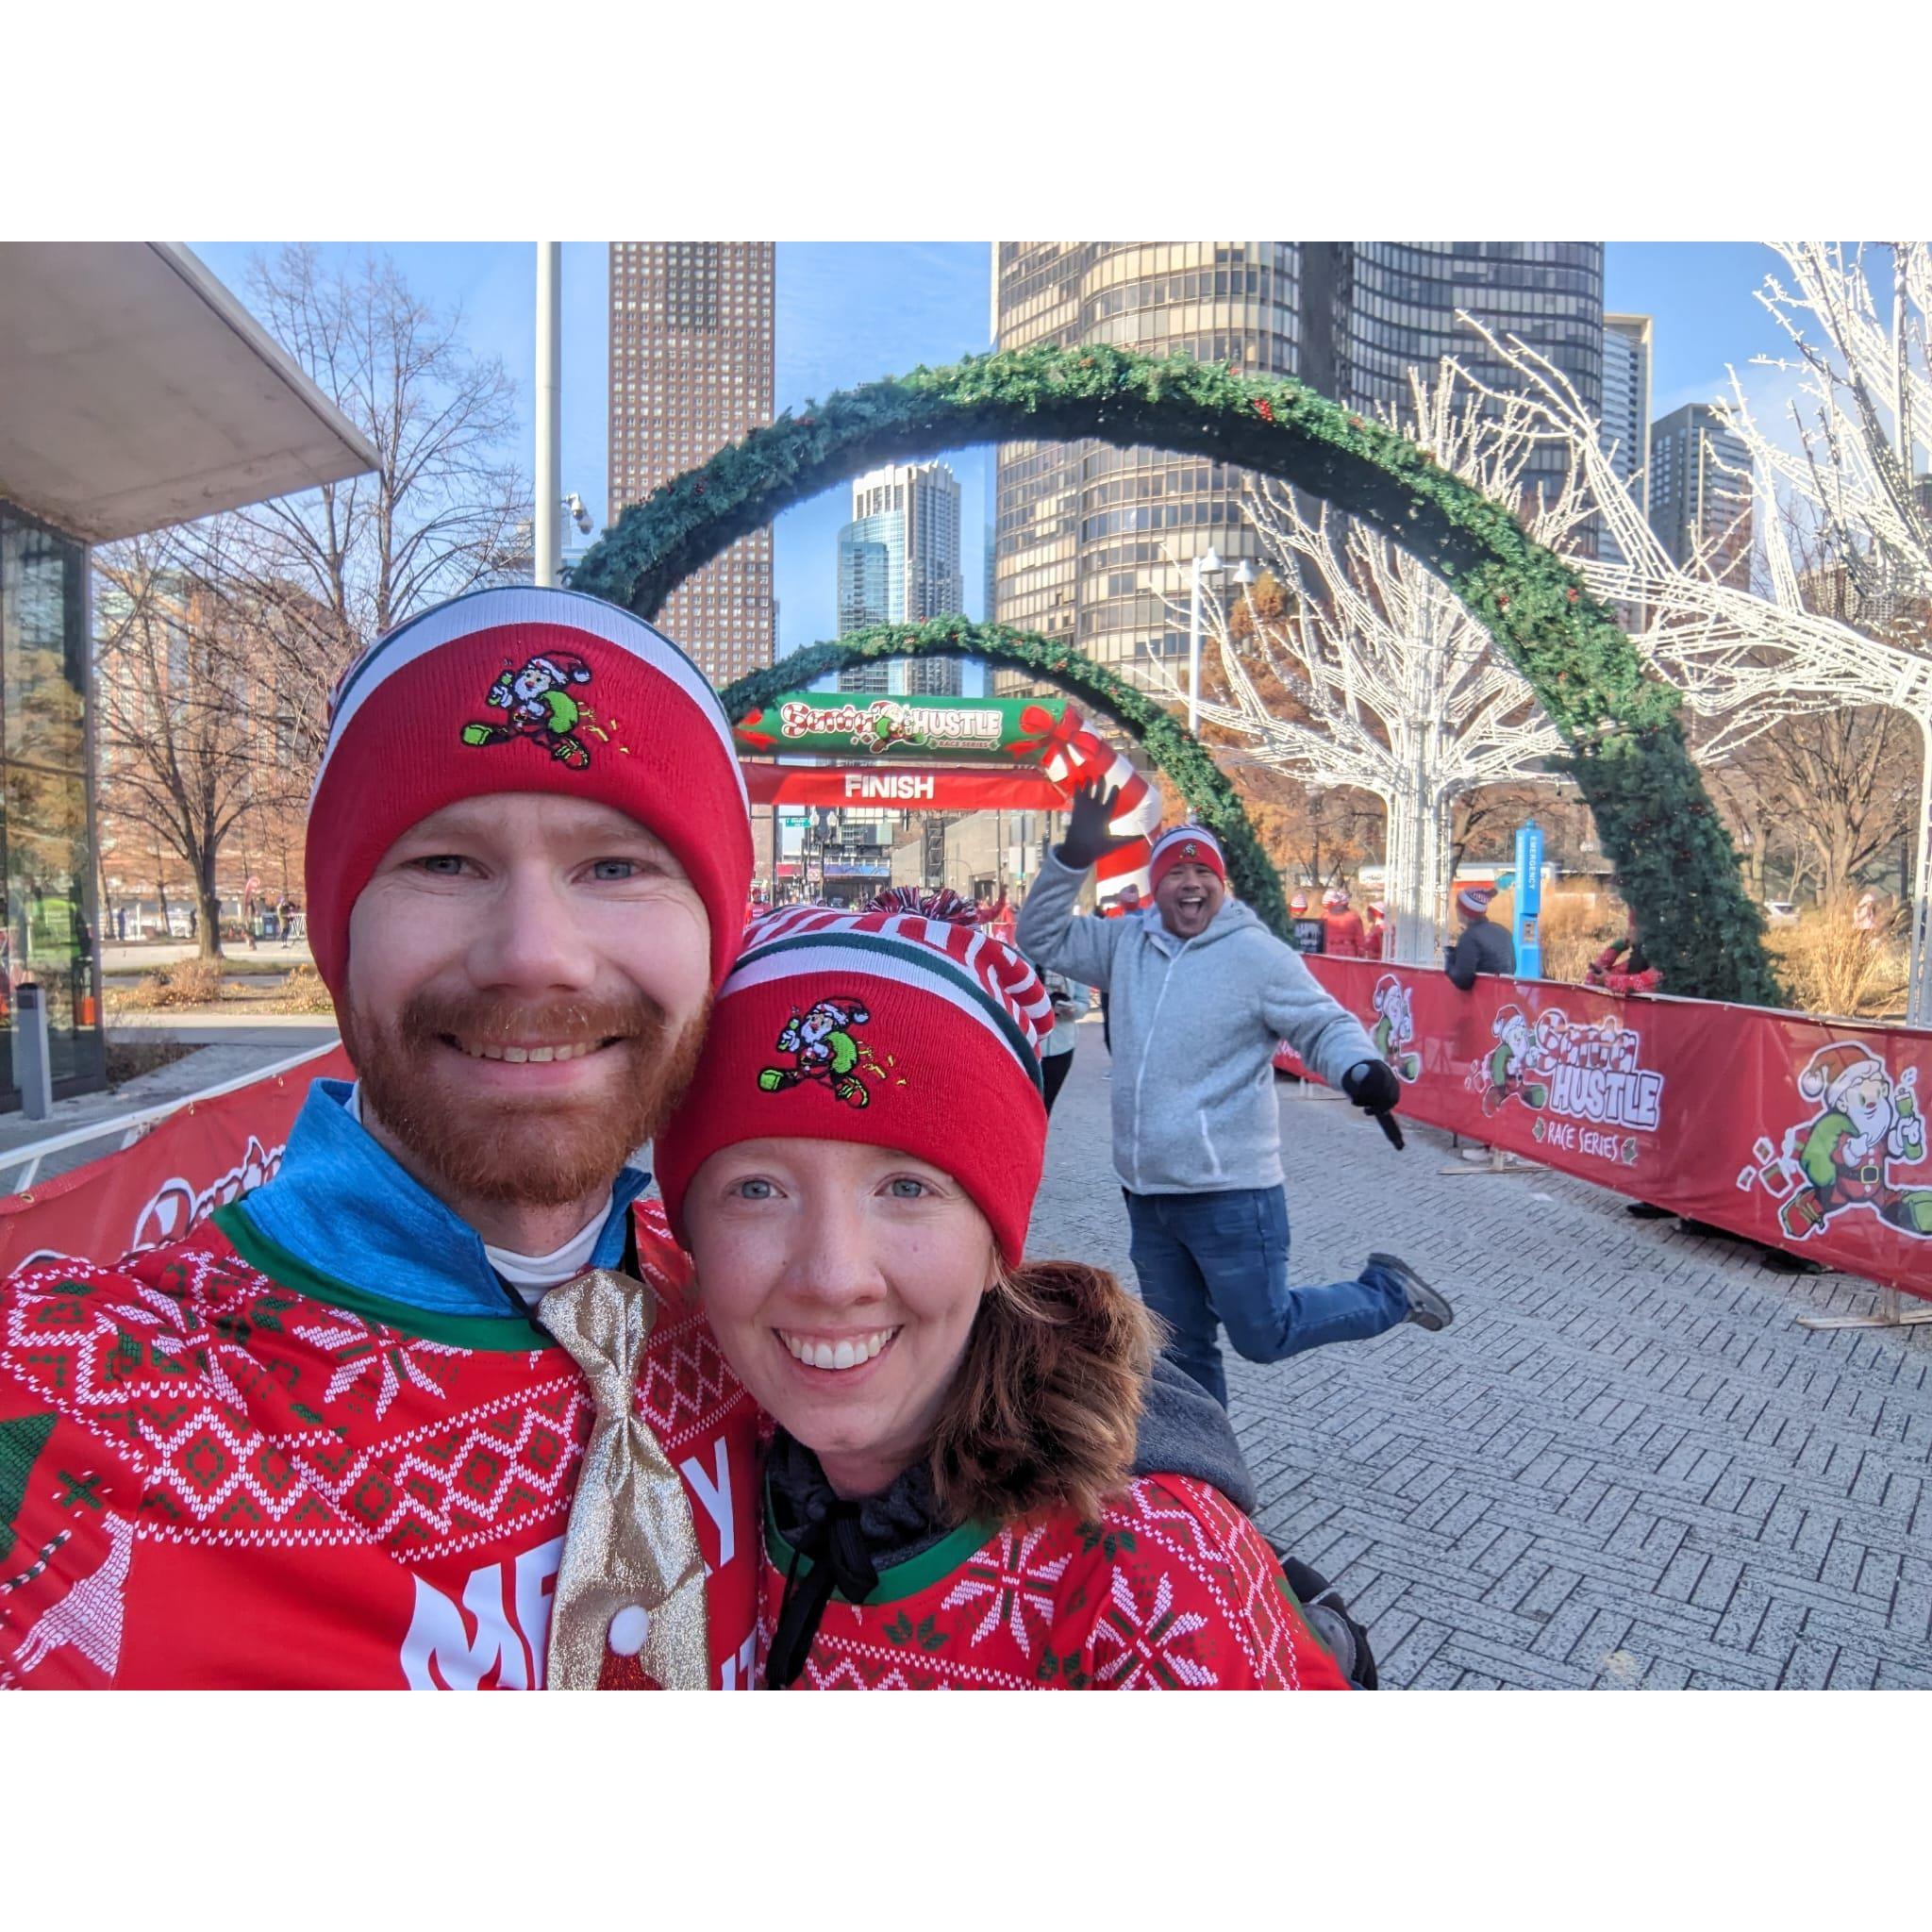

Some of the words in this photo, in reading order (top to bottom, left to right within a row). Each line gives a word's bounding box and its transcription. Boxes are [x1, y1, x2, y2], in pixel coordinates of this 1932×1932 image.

[781, 702, 878, 738] Santa
[911, 708, 1002, 738] HUSTLE
[845, 774, 934, 799] FINISH
[1528, 836, 1538, 891] EMERGENCY
[1550, 1063, 1664, 1131] HUSTLE
[1547, 1122, 1575, 1150] RACE
[1578, 1126, 1619, 1161] SERIES
